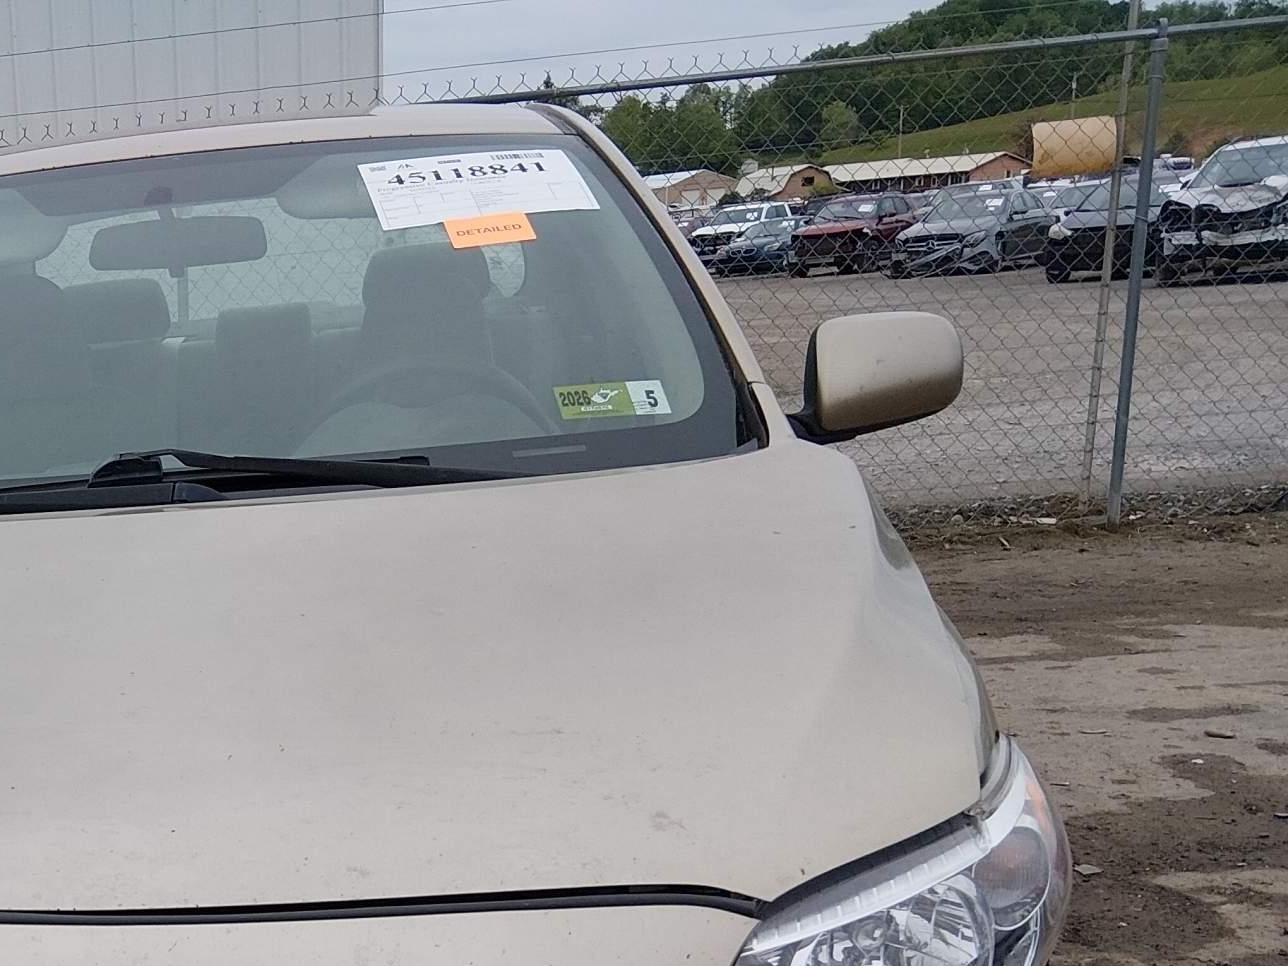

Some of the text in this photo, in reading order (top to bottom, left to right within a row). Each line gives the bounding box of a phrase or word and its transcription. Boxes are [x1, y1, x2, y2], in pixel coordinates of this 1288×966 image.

[387, 161, 547, 185] 45118841
[456, 223, 522, 237] DETAILED
[559, 390, 591, 408] 2026
[644, 389, 659, 408] 5
